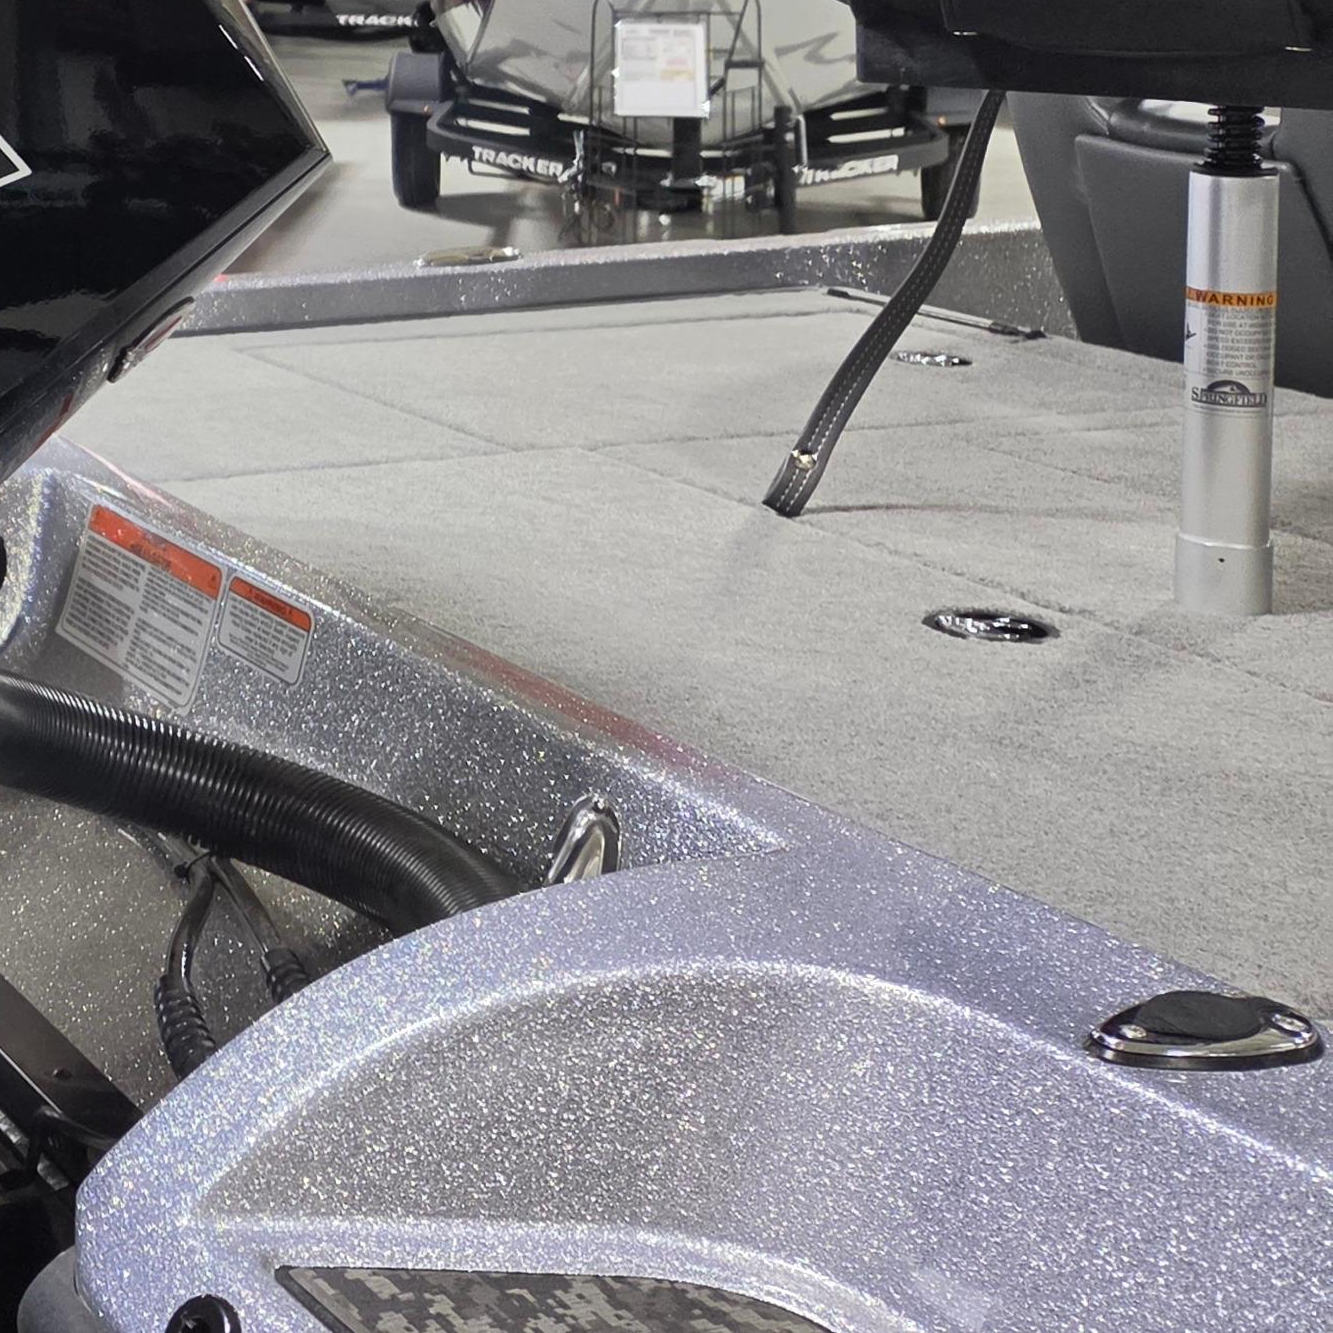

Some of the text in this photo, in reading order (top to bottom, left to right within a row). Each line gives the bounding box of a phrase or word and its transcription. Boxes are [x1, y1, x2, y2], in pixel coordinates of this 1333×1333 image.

[336, 14, 419, 28] TRACK
[472, 145, 564, 177] TRACKER
[1195, 291, 1274, 307] WARNING
[1191, 386, 1268, 406] SPRINGFIELD
